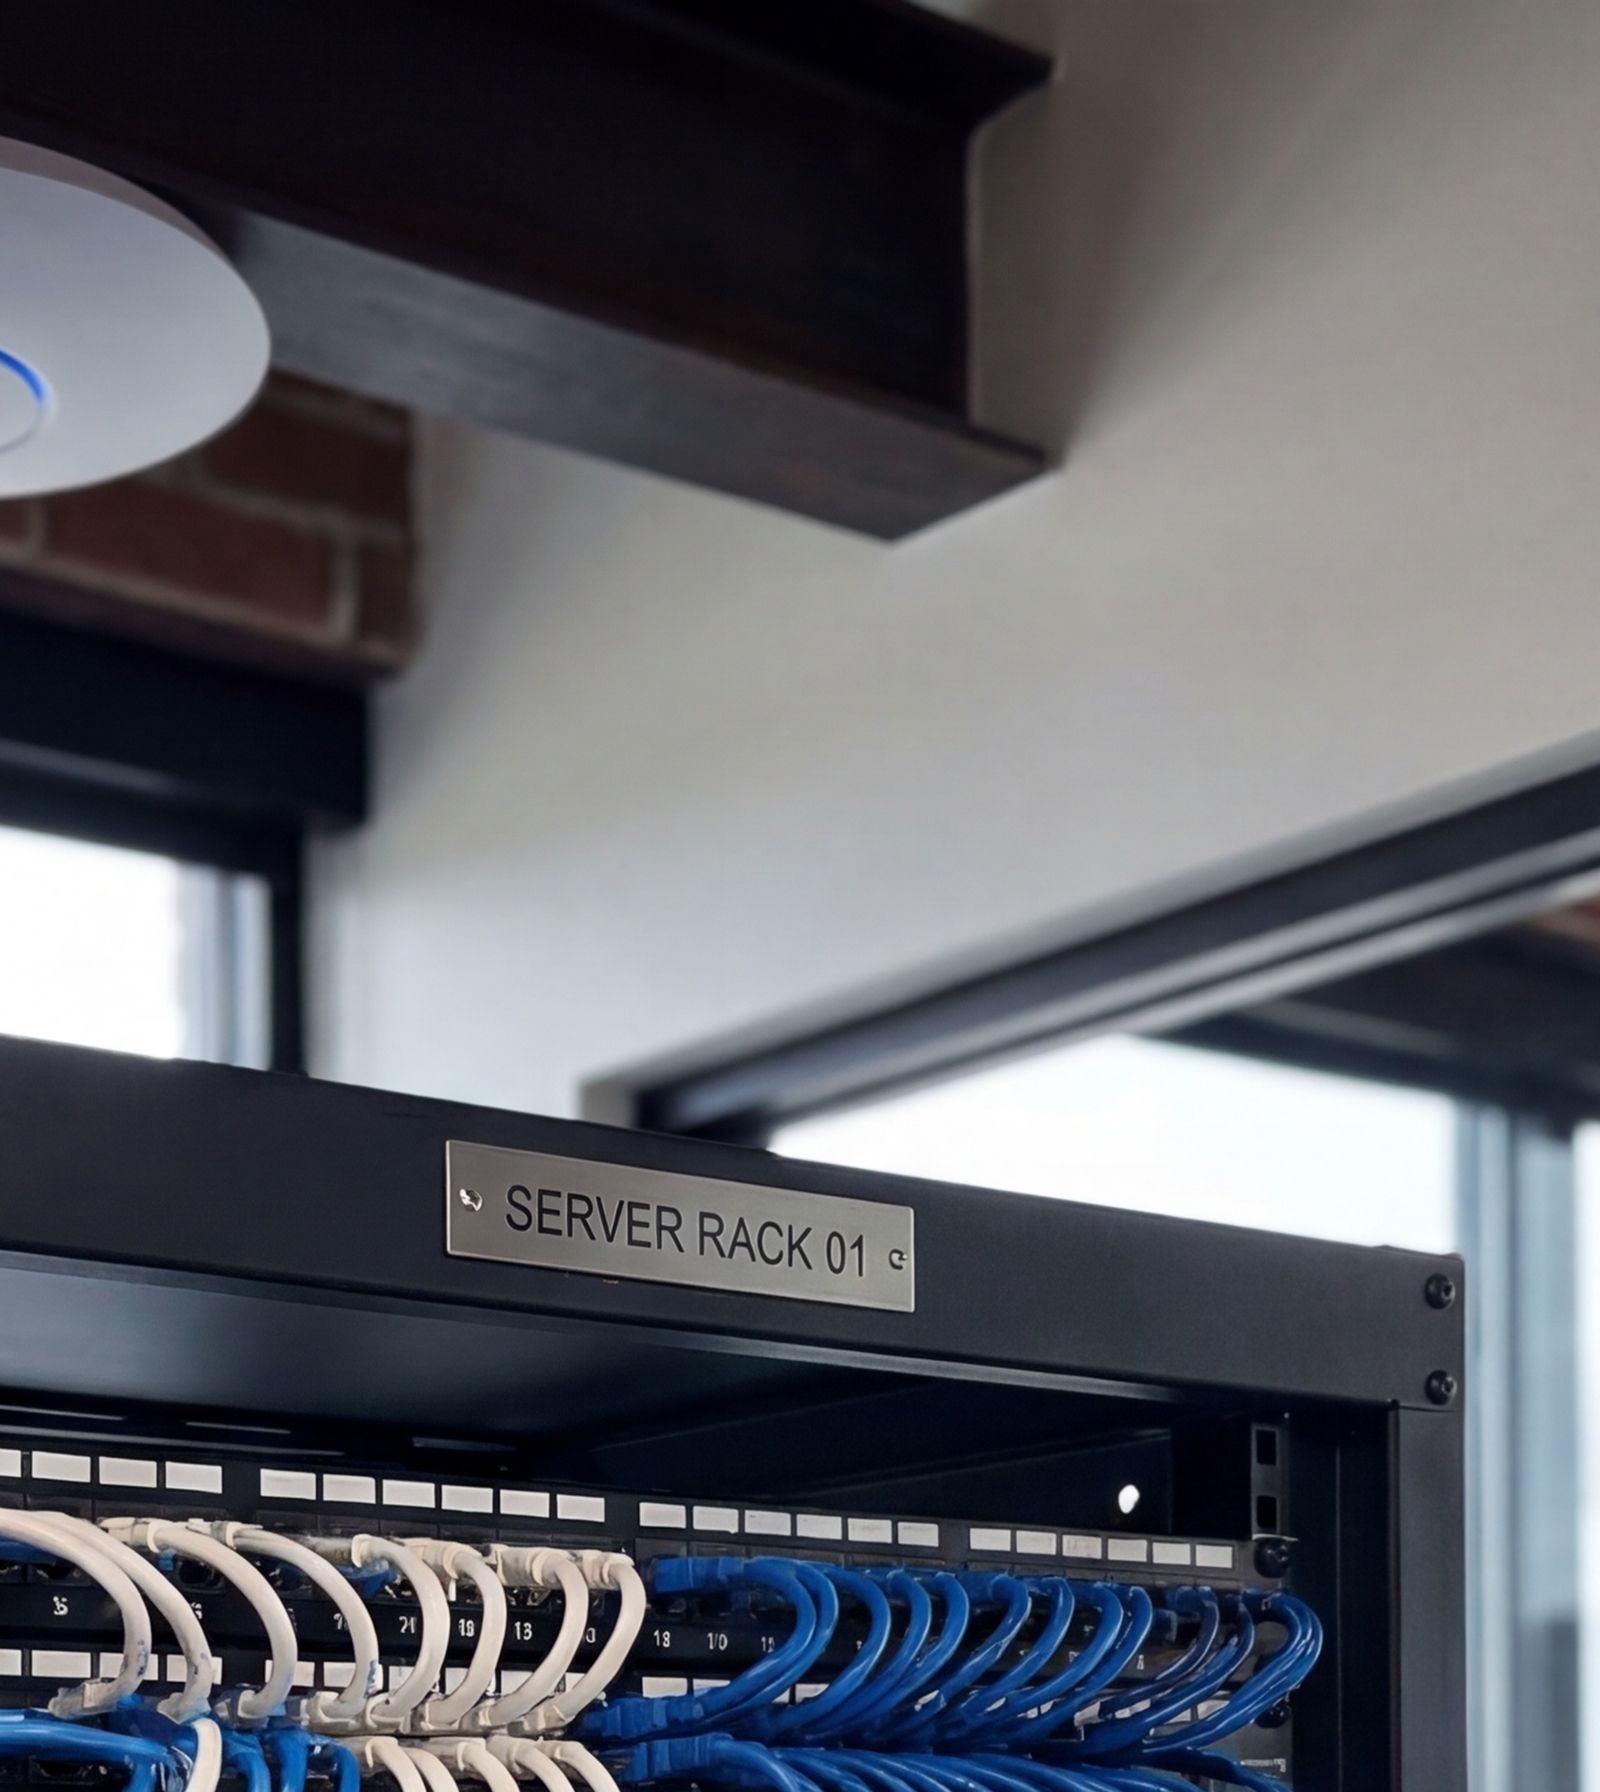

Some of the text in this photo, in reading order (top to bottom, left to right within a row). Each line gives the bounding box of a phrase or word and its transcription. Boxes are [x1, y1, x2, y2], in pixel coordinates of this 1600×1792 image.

[505, 1184, 864, 1278] SERVER RACK 01
